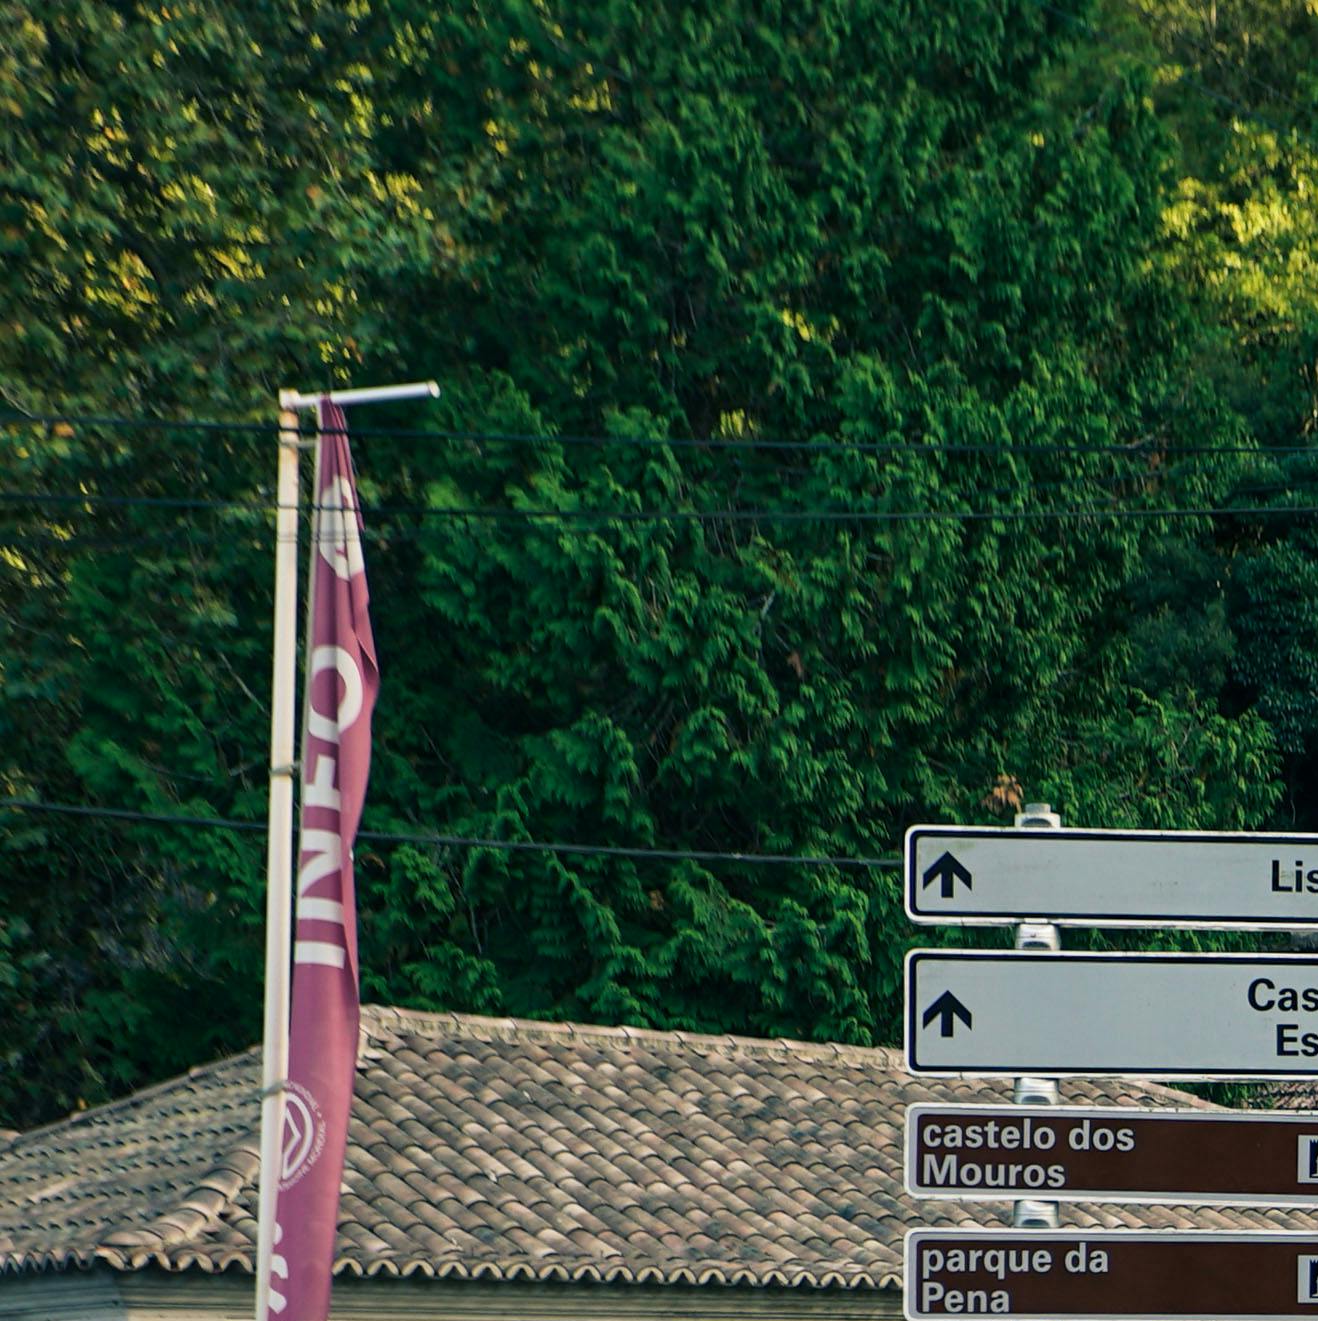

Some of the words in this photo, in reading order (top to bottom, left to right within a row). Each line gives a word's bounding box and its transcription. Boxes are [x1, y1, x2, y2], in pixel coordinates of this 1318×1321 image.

[922, 1118, 1056, 1149] castelo
[1068, 1119, 1135, 1151] dos
[922, 1153, 1066, 1187] Mouros
[922, 1248, 1052, 1280] parque
[1064, 1242, 1109, 1273] da
[922, 1281, 1010, 1313] Pena
